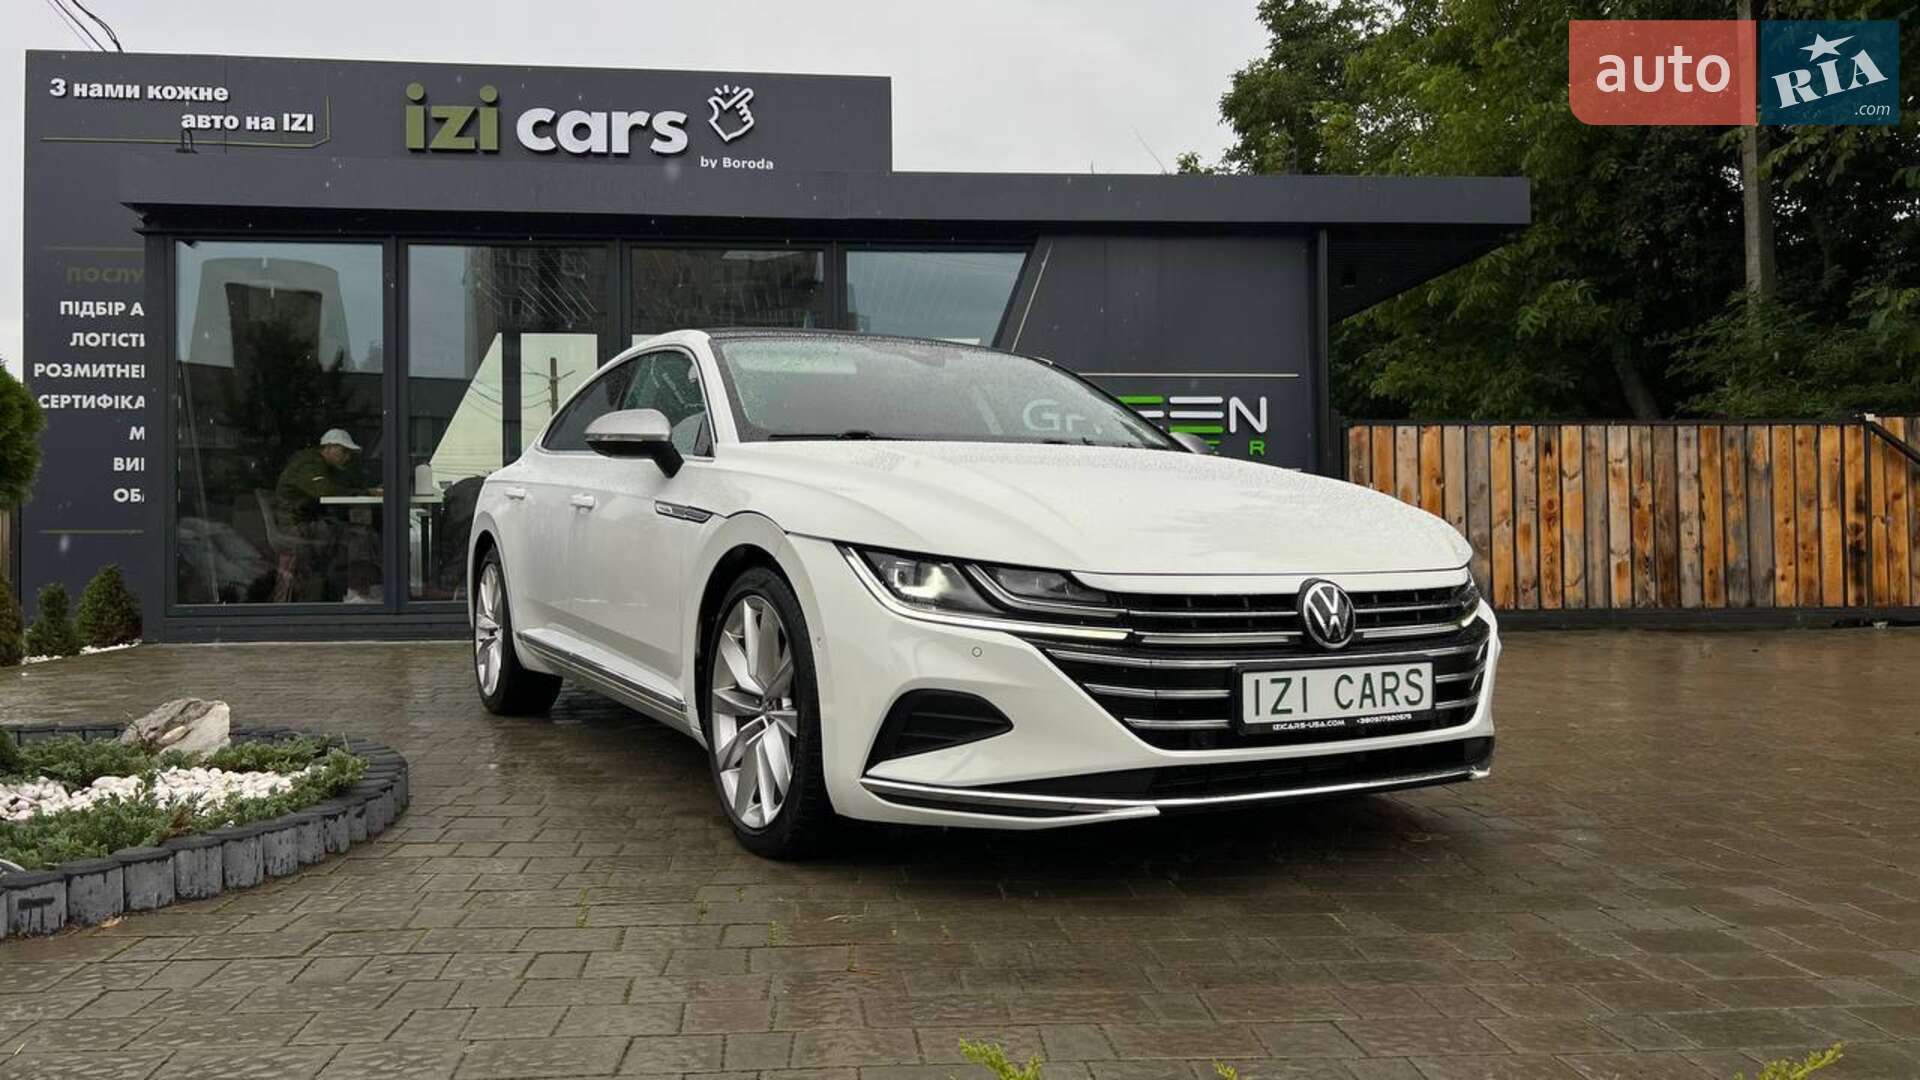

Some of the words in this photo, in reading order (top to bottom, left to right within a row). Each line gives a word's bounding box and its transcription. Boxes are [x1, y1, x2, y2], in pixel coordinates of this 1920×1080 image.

[50, 78, 67, 98] З
[73, 81, 141, 99] нами
[147, 84, 230, 102] кожне
[181, 113, 240, 130] авто
[245, 116, 276, 132] на
[282, 113, 315, 133] IZI
[405, 82, 499, 150] izi
[516, 107, 690, 155] cars
[700, 156, 718, 169] by
[722, 156, 775, 170] Boroda
[60, 300, 126, 318] ПІДБІР
[130, 301, 145, 316] А
[1254, 676, 1308, 717] IZI
[1334, 668, 1424, 710] CARS
